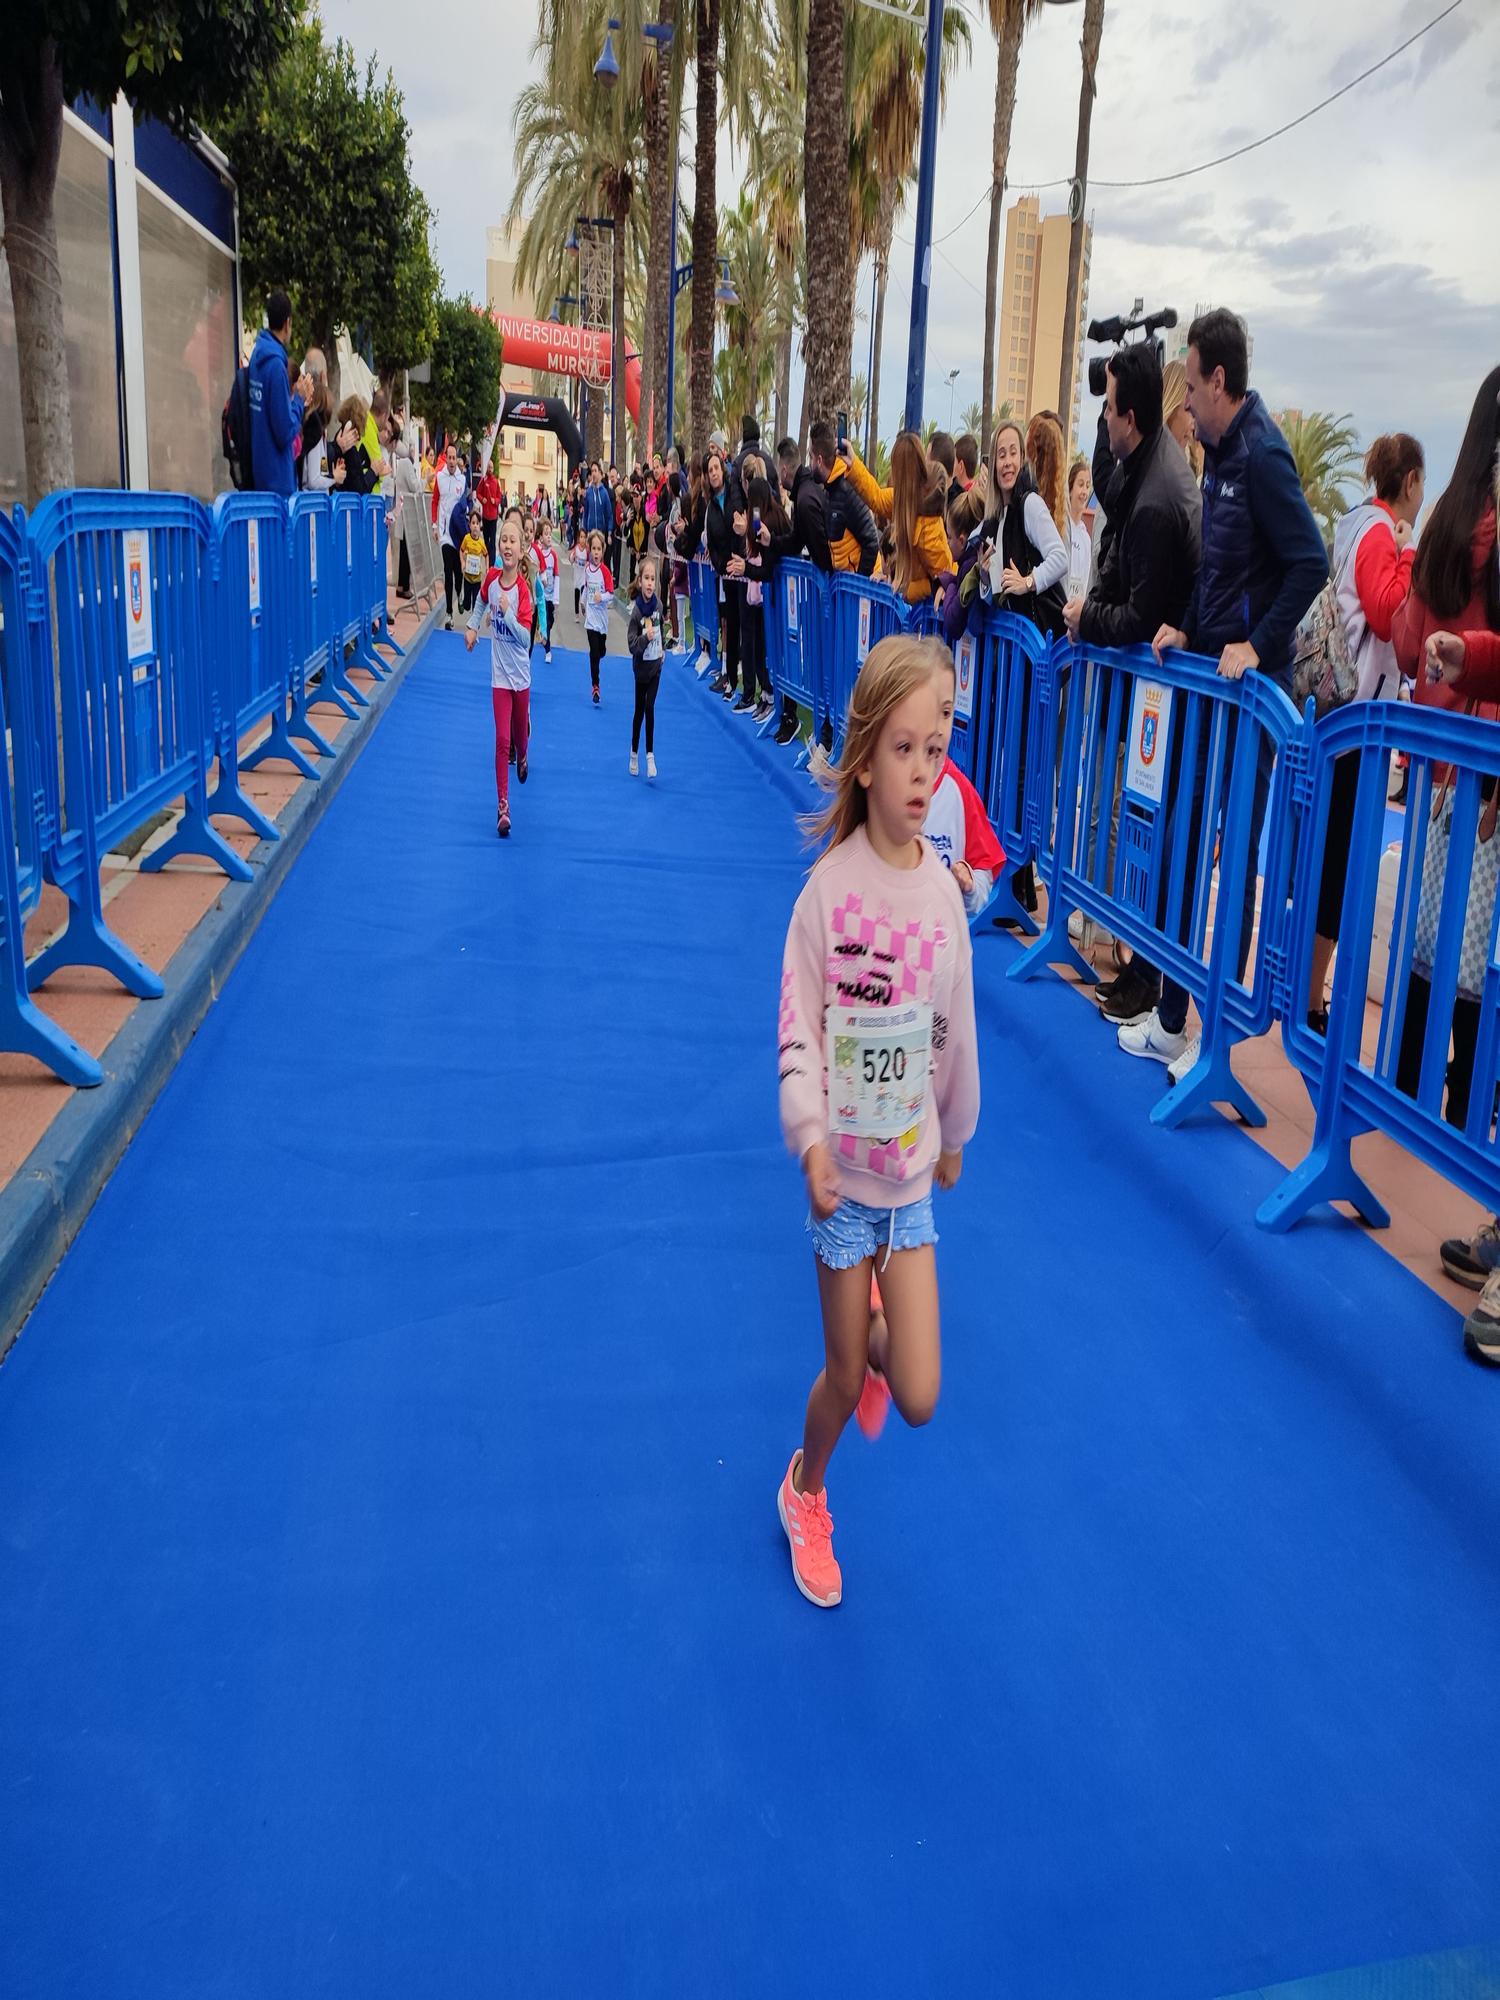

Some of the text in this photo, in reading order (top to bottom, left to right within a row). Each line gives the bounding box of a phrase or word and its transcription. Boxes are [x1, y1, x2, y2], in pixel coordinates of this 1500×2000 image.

[583, 333, 600, 353] DE
[547, 352, 600, 378] MURCIA
[862, 1046, 906, 1084] 520
